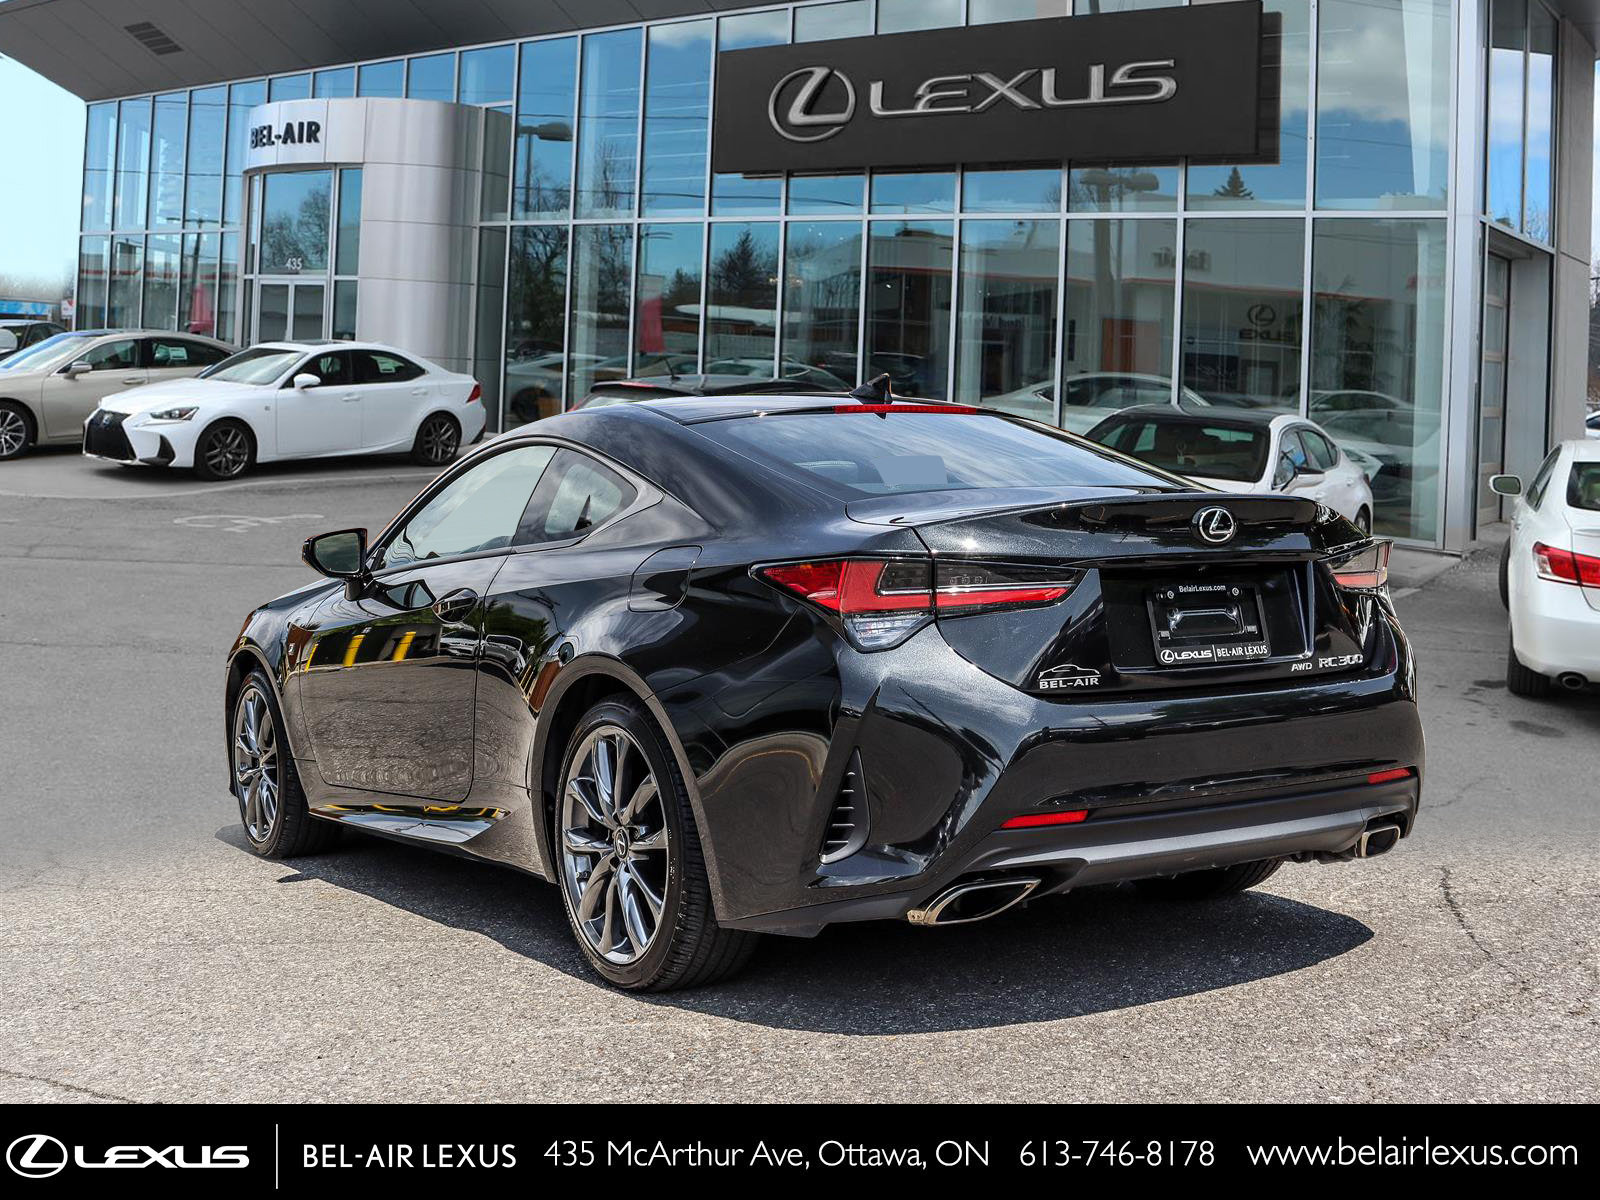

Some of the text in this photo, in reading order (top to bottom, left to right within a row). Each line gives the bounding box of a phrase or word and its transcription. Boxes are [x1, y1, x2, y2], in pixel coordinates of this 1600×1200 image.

[869, 59, 1177, 118] LEXUS
[250, 121, 321, 149] BEL-AIR
[286, 257, 303, 270] 435
[1178, 585, 1226, 593] BelairLexus.com
[1175, 650, 1212, 660] LEXUS
[1244, 644, 1268, 655] LEXUS
[1291, 662, 1313, 672] AWD
[1039, 677, 1100, 690] BEL-AIR
